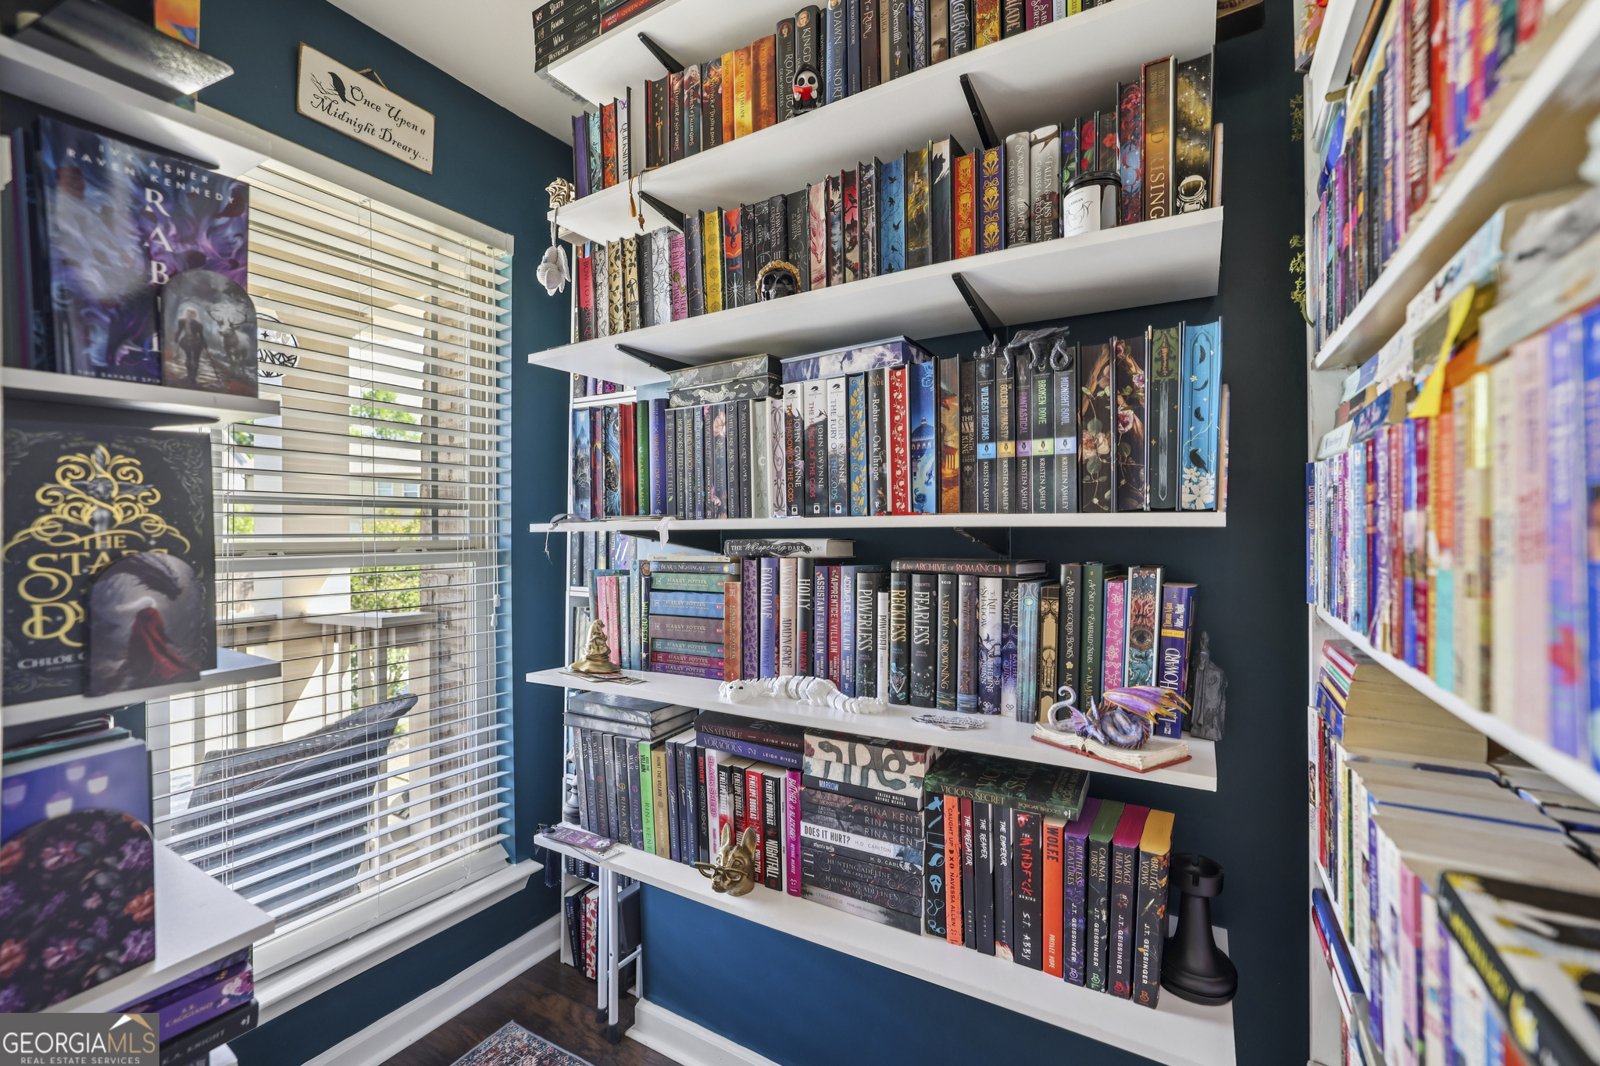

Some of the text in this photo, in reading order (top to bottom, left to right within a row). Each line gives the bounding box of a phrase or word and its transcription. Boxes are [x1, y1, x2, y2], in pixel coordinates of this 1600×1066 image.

[832, 9, 842, 44] DAWN
[802, 28, 812, 64] KINGD
[784, 53, 794, 84] ROAD
[310, 93, 428, 160] Midnight Dreary...
[350, 85, 426, 136] Once Upon a
[66, 148, 235, 204] RAVEN KENNEDY
[150, 160, 210, 184] ASHER
[1044, 157, 1054, 190] FALLEN
[1149, 153, 1166, 220] RISING
[981, 386, 989, 441] WILDEST DREAMS
[1038, 380, 1046, 424] BROKEN DOVE
[1061, 376, 1069, 426] MIDNIGHT SOUL
[809, 450, 815, 460] OF
[830, 442, 838, 455] OF
[872, 454, 883, 481] Throne
[84, 534, 127, 550] THE
[743, 542, 787, 553] Whispering
[915, 564, 946, 572] ARCHIVE
[762, 567, 773, 619] FOXGLOVE
[783, 565, 793, 608] WISTERIA
[798, 578, 810, 610] HOLLY
[816, 576, 824, 654] ASSISTANT VILLAIN
[858, 589, 873, 651] POWERLESS
[891, 590, 906, 642] RECKLESS
[914, 591, 929, 644] FEARLESS
[941, 600, 949, 628] STUDY
[988, 598, 998, 616] KILL
[782, 618, 792, 668] ADALYN GRACE
[1065, 613, 1074, 658] GOLDEN BONES
[1087, 614, 1096, 663] EMERALD STARS
[941, 640, 950, 689] DROWNING
[1160, 648, 1182, 690] HOWARD
[703, 738, 742, 753] VORACIOUS
[780, 756, 798, 764] RIVERS
[708, 756, 716, 818] BLACK SHEEP
[734, 772, 742, 817] PENELOPE DOUGLAS
[749, 775, 757, 820] PENELOPE DOUGLAS
[766, 780, 774, 826] PENELOPE DOUGLAS
[940, 784, 1004, 805] VICIOUS SECRET
[863, 806, 920, 824] RINA KENT
[864, 817, 920, 835] RINA KENT
[804, 825, 851, 845] DOES IT HURT?
[864, 828, 919, 846] RINA KENT
[949, 837, 954, 846] UP
[964, 829, 972, 866] PREDATOR
[766, 840, 778, 878] NIGHTFALL
[827, 858, 890, 879] HUNTING ADELINE
[1067, 842, 1076, 885] CREATURES
[1075, 845, 1083, 884] RUTHLESS
[1090, 850, 1099, 876] URGES
[1114, 852, 1123, 884] HEARTS
[1141, 860, 1149, 885] VOWS
[1150, 858, 1159, 890] BRUTAL
[825, 876, 861, 890] HAUNTING
[1022, 912, 1031, 960] S.T. ABBY
